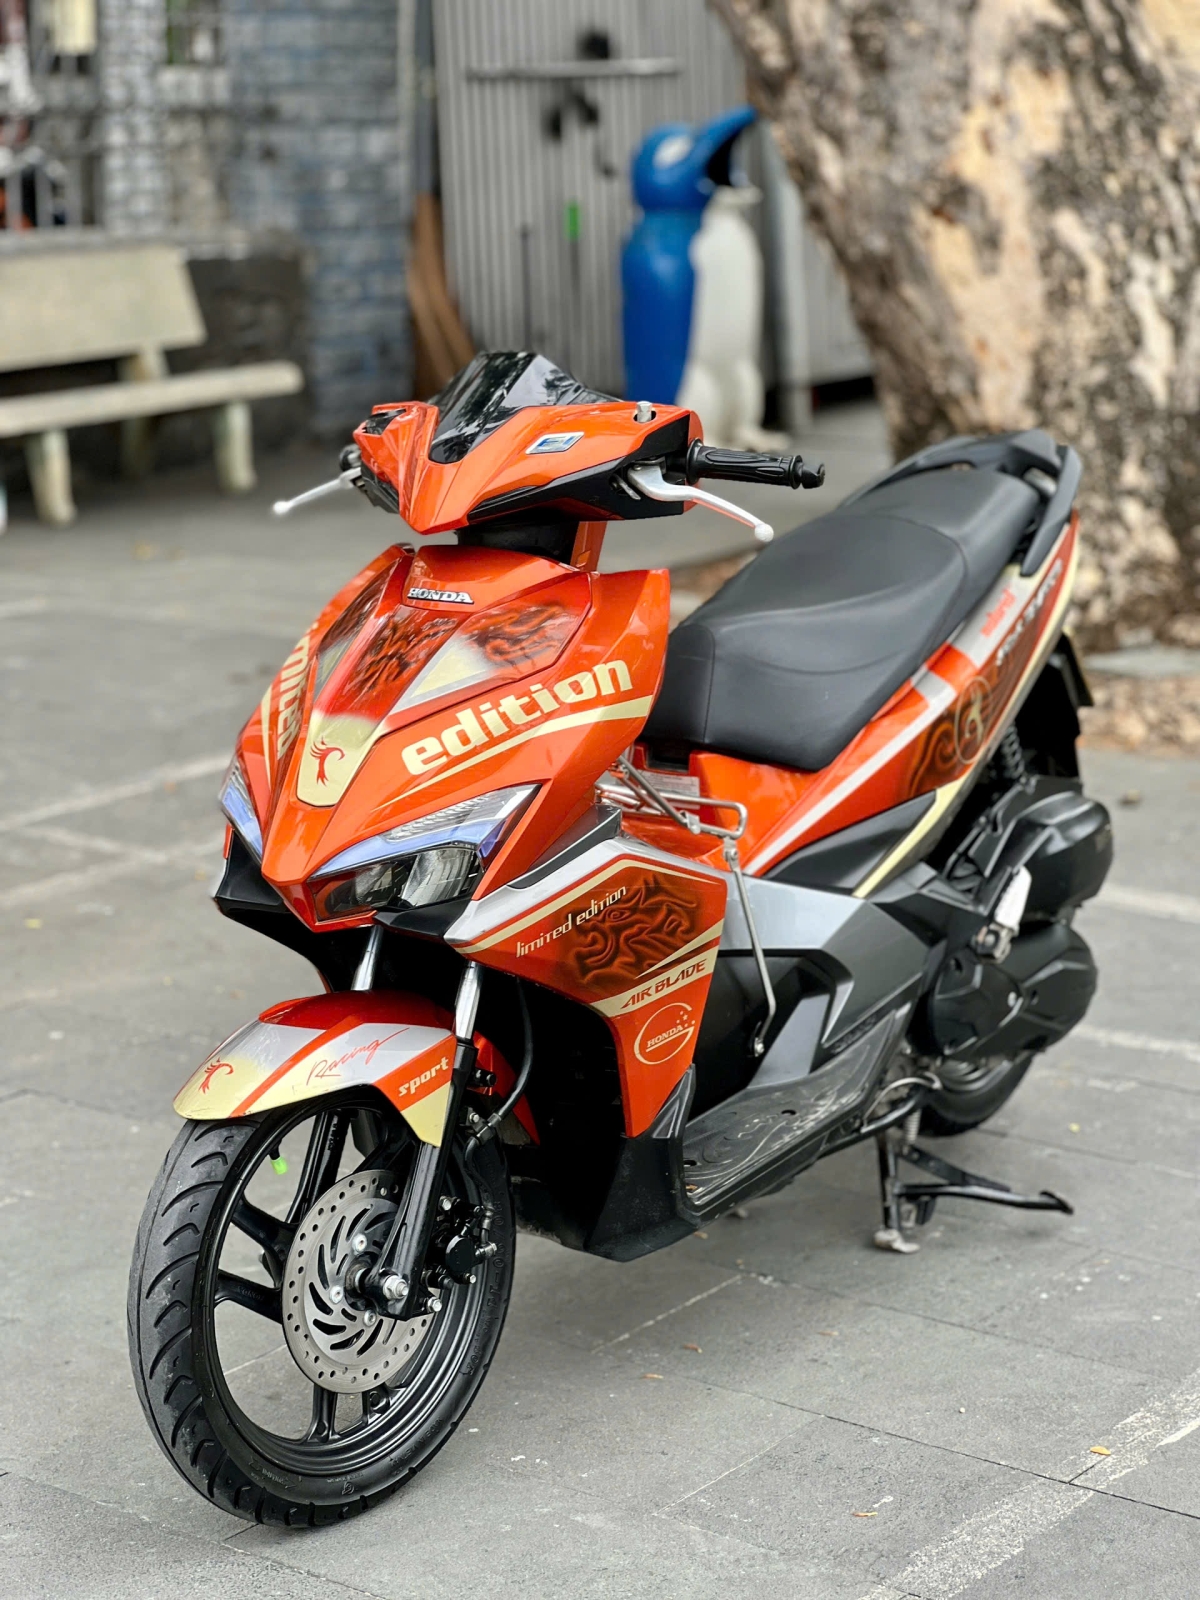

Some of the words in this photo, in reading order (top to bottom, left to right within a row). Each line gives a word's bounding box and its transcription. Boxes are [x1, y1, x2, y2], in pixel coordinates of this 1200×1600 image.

[407, 587, 474, 604] HONDA
[402, 659, 633, 776] edition
[515, 913, 573, 958] limited
[576, 885, 627, 926] edition
[620, 984, 653, 1010] AIR
[654, 958, 707, 995] BLADE
[306, 1027, 410, 1086] Racing
[646, 1024, 684, 1049] HONDA
[398, 1056, 449, 1097] sport
